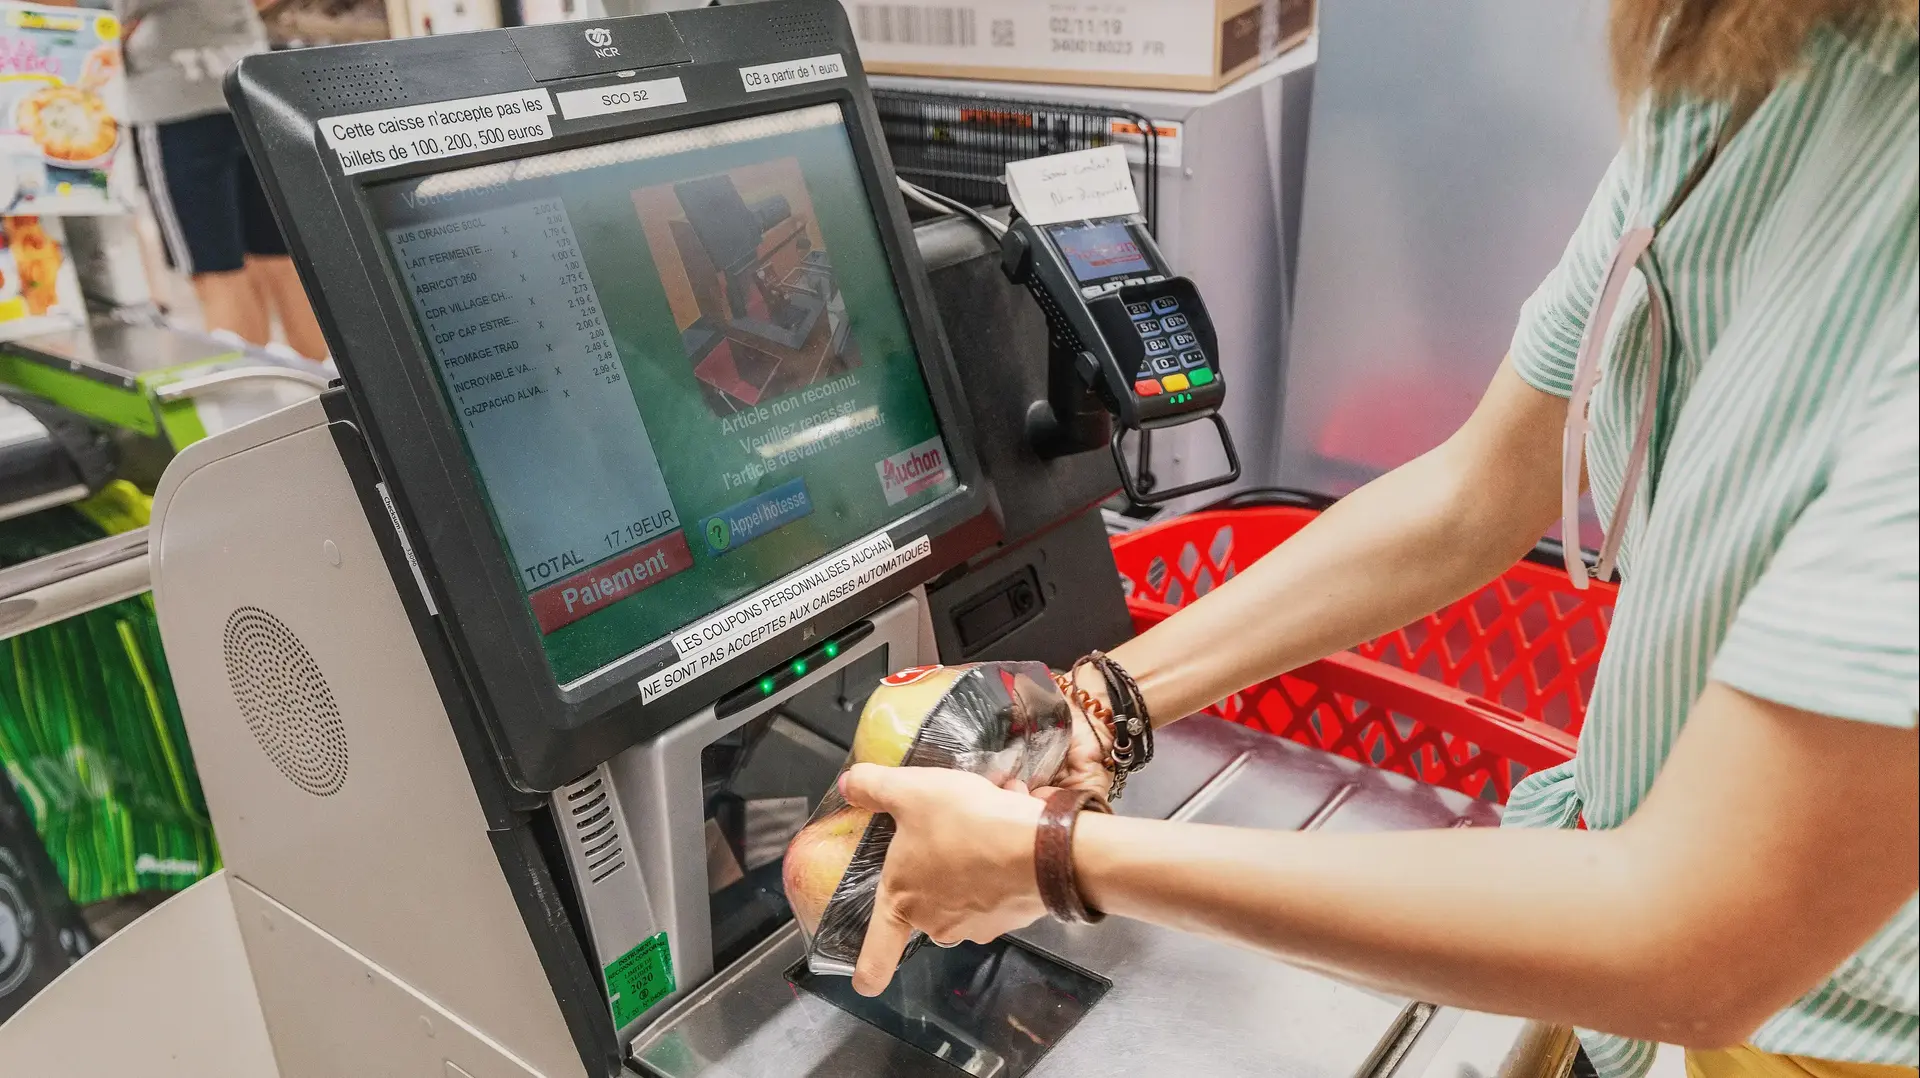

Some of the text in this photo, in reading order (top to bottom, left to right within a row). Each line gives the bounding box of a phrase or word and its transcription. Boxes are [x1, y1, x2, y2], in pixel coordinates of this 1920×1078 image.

[594, 47, 621, 59] NCR
[745, 62, 839, 87] CB a partir de 1 euro
[332, 98, 543, 141] Cette caisse n'accepte pas les
[601, 89, 649, 107] SCO 52
[340, 123, 544, 169] billets de 100, 200, 500 euros
[396, 232, 415, 244] JUS
[418, 222, 460, 239] ORANGE
[401, 248, 407, 256] 1
[404, 257, 426, 270] LAIT
[428, 245, 482, 264] FERMENTE
[411, 273, 417, 281] 1
[416, 276, 458, 295] ABRICOT
[552, 251, 568, 261] 1.00
[420, 298, 427, 306] 1
[425, 306, 448, 320] CDR
[448, 296, 490, 313] VILLAGE
[560, 273, 577, 285] 2.73
[430, 284, 588, 332] 1 X 2.73
[435, 331, 455, 344] CDP
[458, 325, 477, 338] CAP
[568, 296, 585, 308] 2.19
[440, 306, 596, 356] 1 X 2.19
[444, 347, 493, 369] FROMAGE
[493, 340, 519, 354] TRAD
[576, 319, 593, 331] 2.00
[449, 328, 605, 380] 1 X 2.00
[453, 367, 515, 394] INCROYABLE
[584, 341, 602, 354] 2.49
[459, 351, 613, 405] 1 X 2.49
[463, 394, 515, 417] GAZPACHO
[592, 364, 610, 376] 2.99
[469, 373, 621, 429] 1 X 2.99
[721, 374, 860, 436] Article non reconnu.
[722, 459, 777, 490] l'article
[883, 448, 942, 490] Auchan
[384, 496, 401, 530] Checksum
[729, 508, 764, 536] Appel
[763, 490, 806, 521] hôtesse
[525, 509, 675, 583] TOTAL 17.19EUR
[561, 549, 668, 614] Paiement
[676, 538, 892, 654] LES COUPONS PERSONNALISES AUCHAN
[643, 540, 930, 699] NE SONT PAS ACCEPTES AUX CAISSES AUTOMATIQUES
[631, 972, 654, 995] 2020
